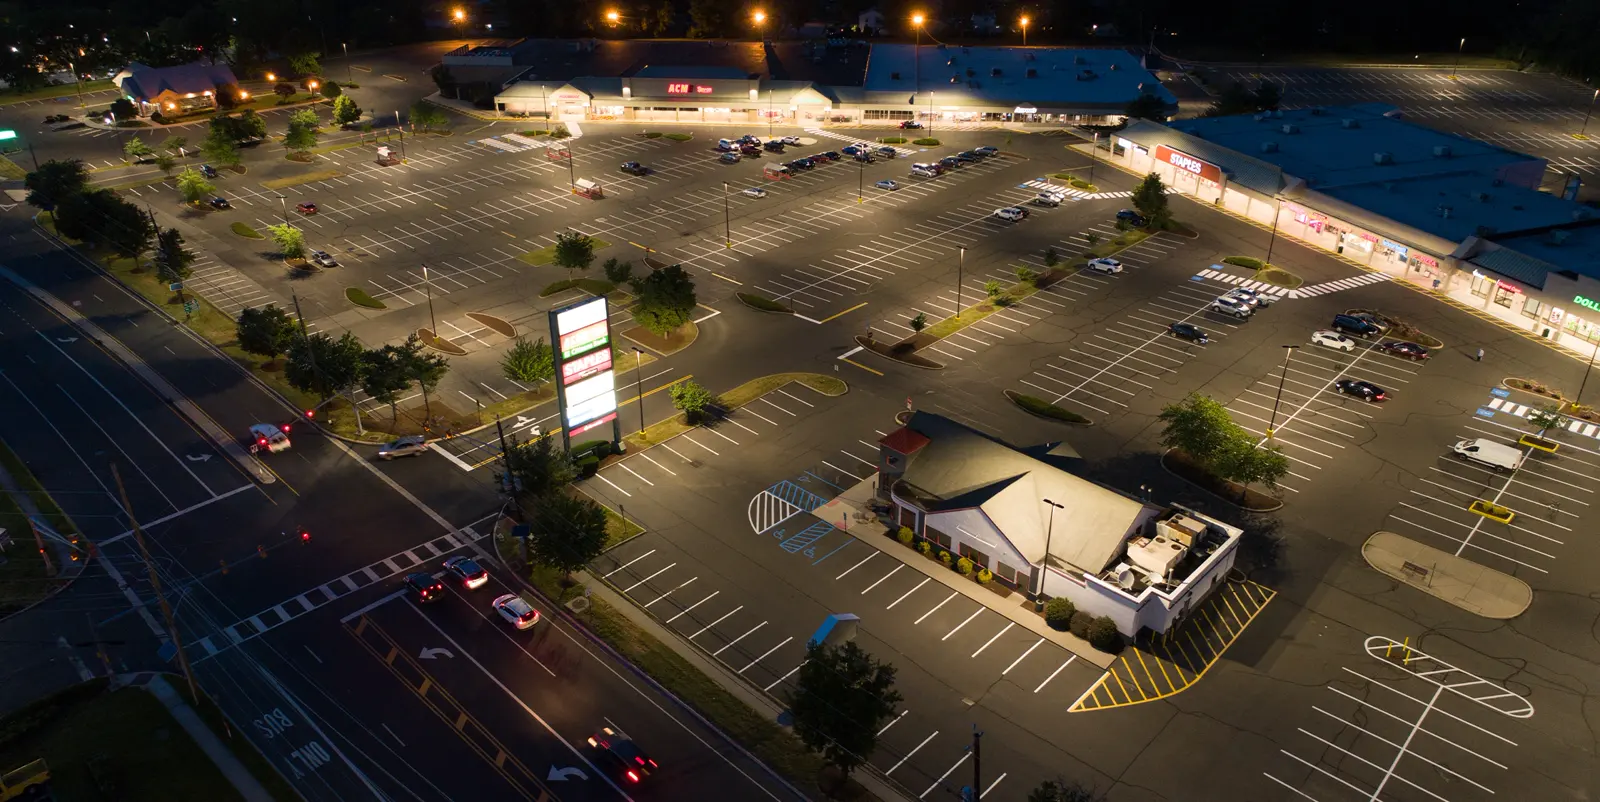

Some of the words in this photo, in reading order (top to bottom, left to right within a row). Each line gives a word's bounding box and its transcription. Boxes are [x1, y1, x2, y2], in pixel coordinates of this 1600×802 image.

[668, 83, 694, 93] ACME
[1170, 153, 1202, 174] STAPLES
[564, 350, 610, 375] STAPLES
[253, 707, 294, 739] BUS
[283, 741, 331, 780] ONLY
